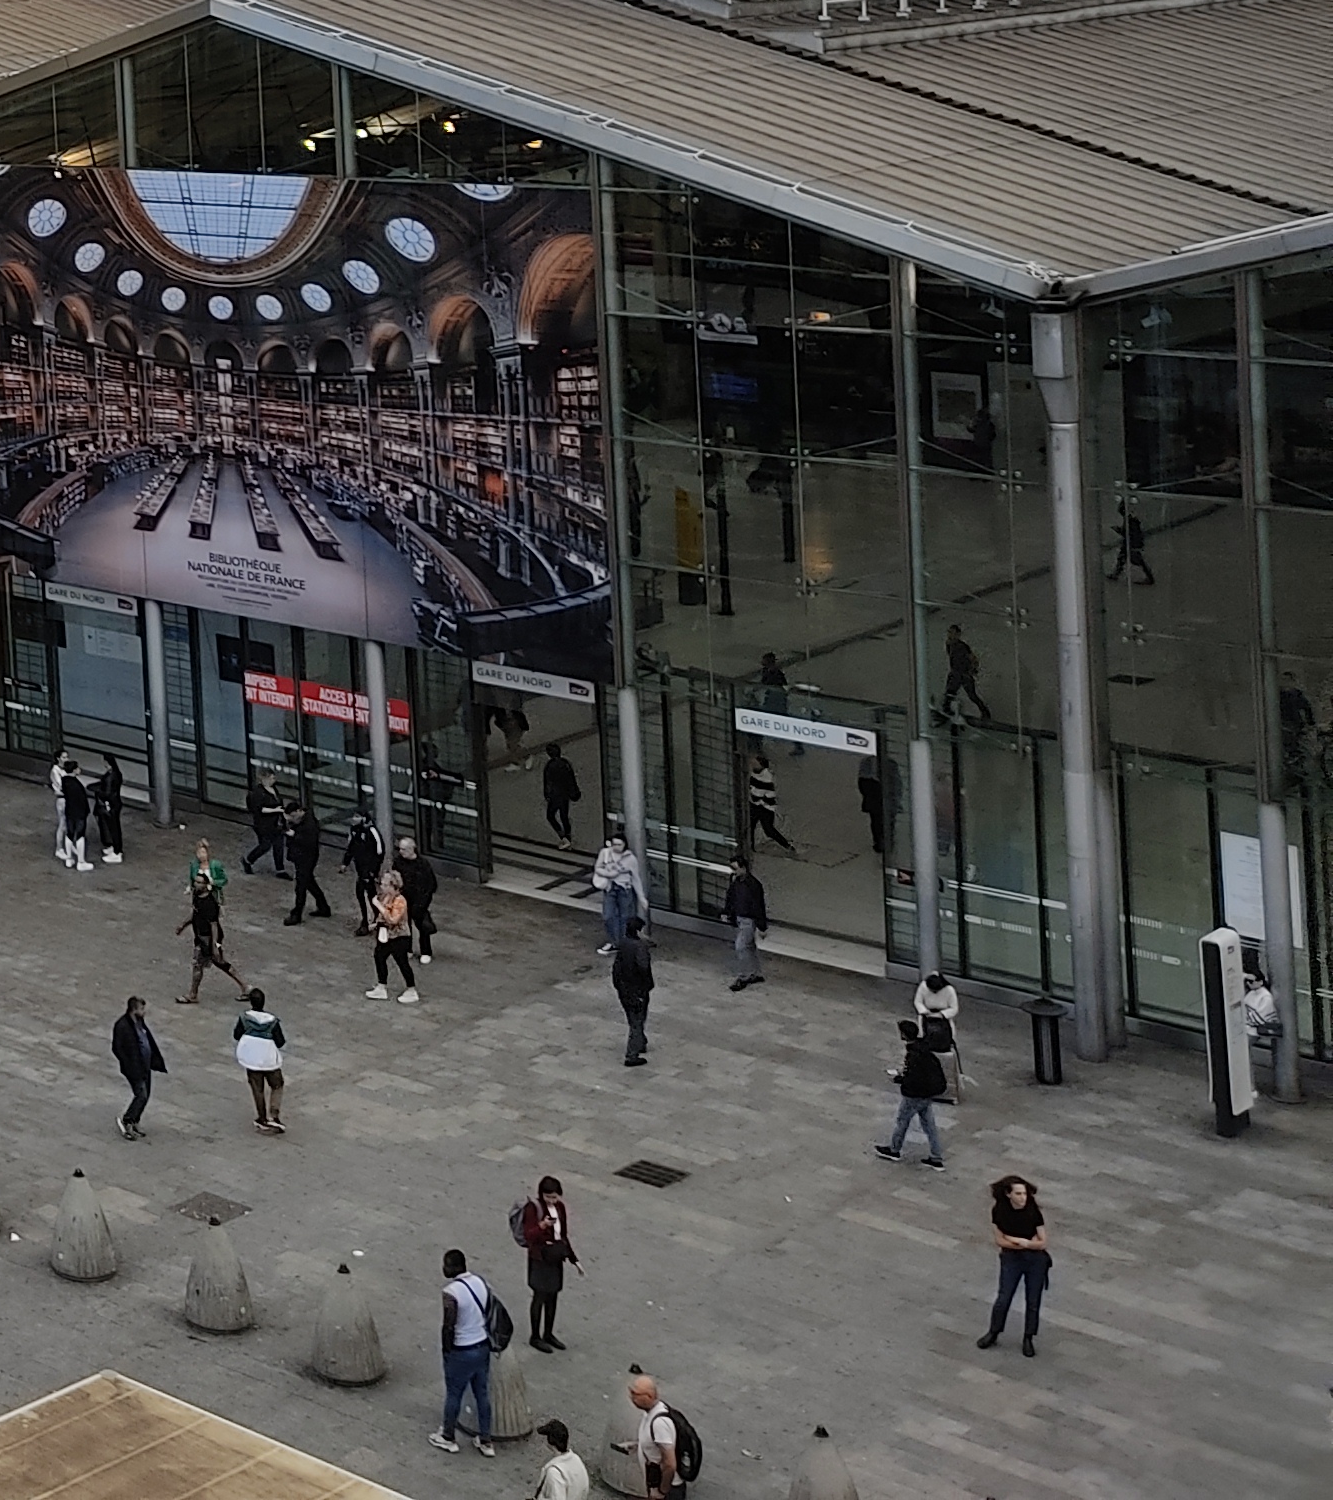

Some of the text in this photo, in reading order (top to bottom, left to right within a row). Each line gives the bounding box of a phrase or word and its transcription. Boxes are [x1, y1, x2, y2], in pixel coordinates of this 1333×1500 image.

[209, 552, 282, 574] BIBLIOTHÈQUE
[187, 560, 244, 580] NATIONALE
[247, 571, 261, 583] DE
[264, 573, 306, 590] FRANCE
[48, 587, 68, 598] GARE
[70, 591, 81, 600] DU
[82, 593, 105, 604] NORD
[476, 667, 503, 680] GARE
[505, 672, 519, 683] DU
[523, 676, 552, 689] NORD
[258, 689, 295, 709] INTERDIT
[319, 686, 346, 705] ACCES
[740, 715, 771, 729] GARE
[773, 721, 789, 732] DU
[793, 725, 826, 739] NORD
